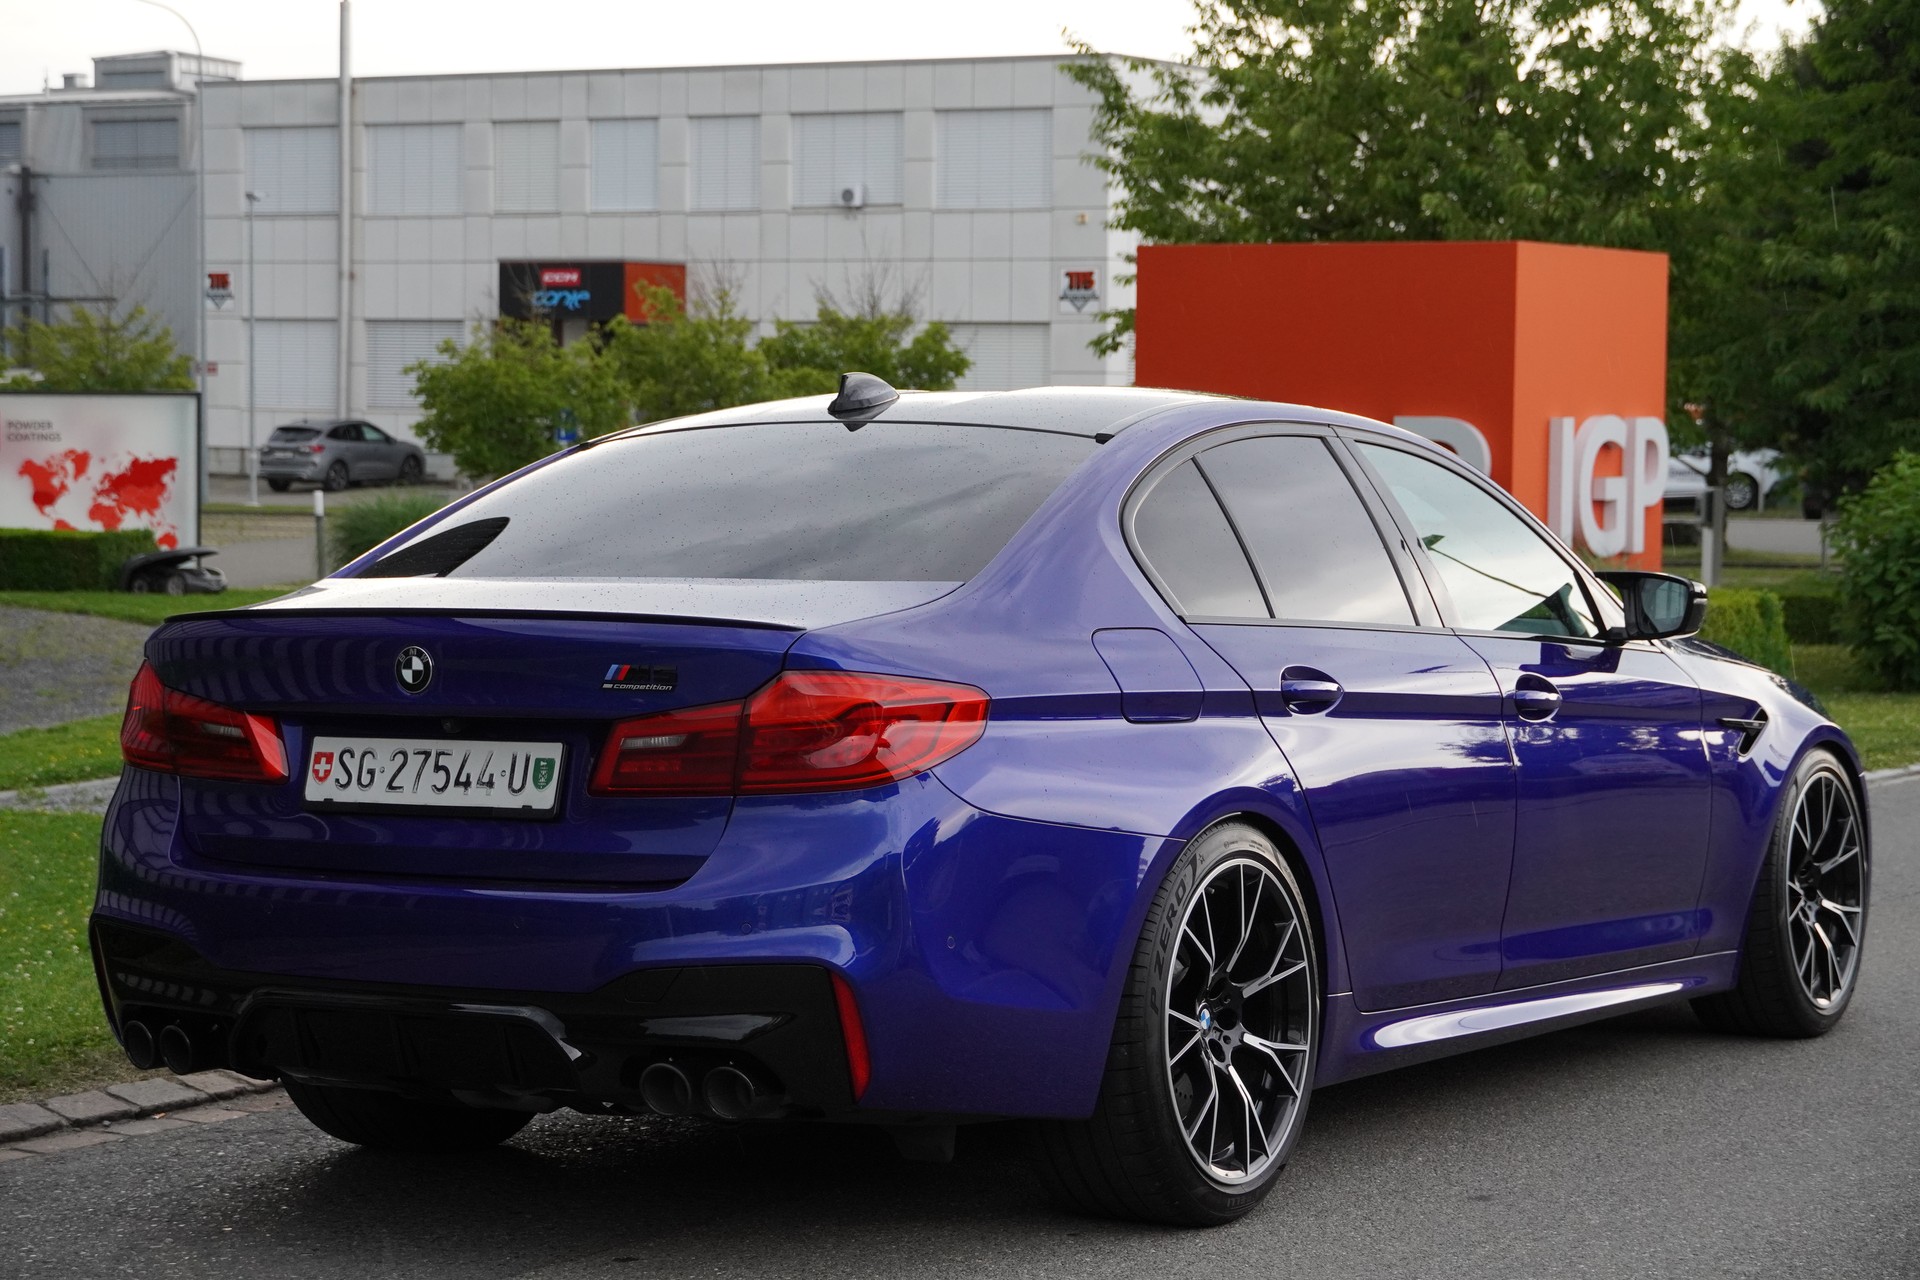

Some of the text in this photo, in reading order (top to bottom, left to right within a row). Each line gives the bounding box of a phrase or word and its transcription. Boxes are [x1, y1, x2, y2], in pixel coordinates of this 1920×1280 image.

[7, 420, 54, 431] POWDER
[7, 432, 62, 442] COATINGS
[1547, 414, 1670, 558] IGP
[399, 648, 429, 662] BMW
[613, 683, 673, 691] competition
